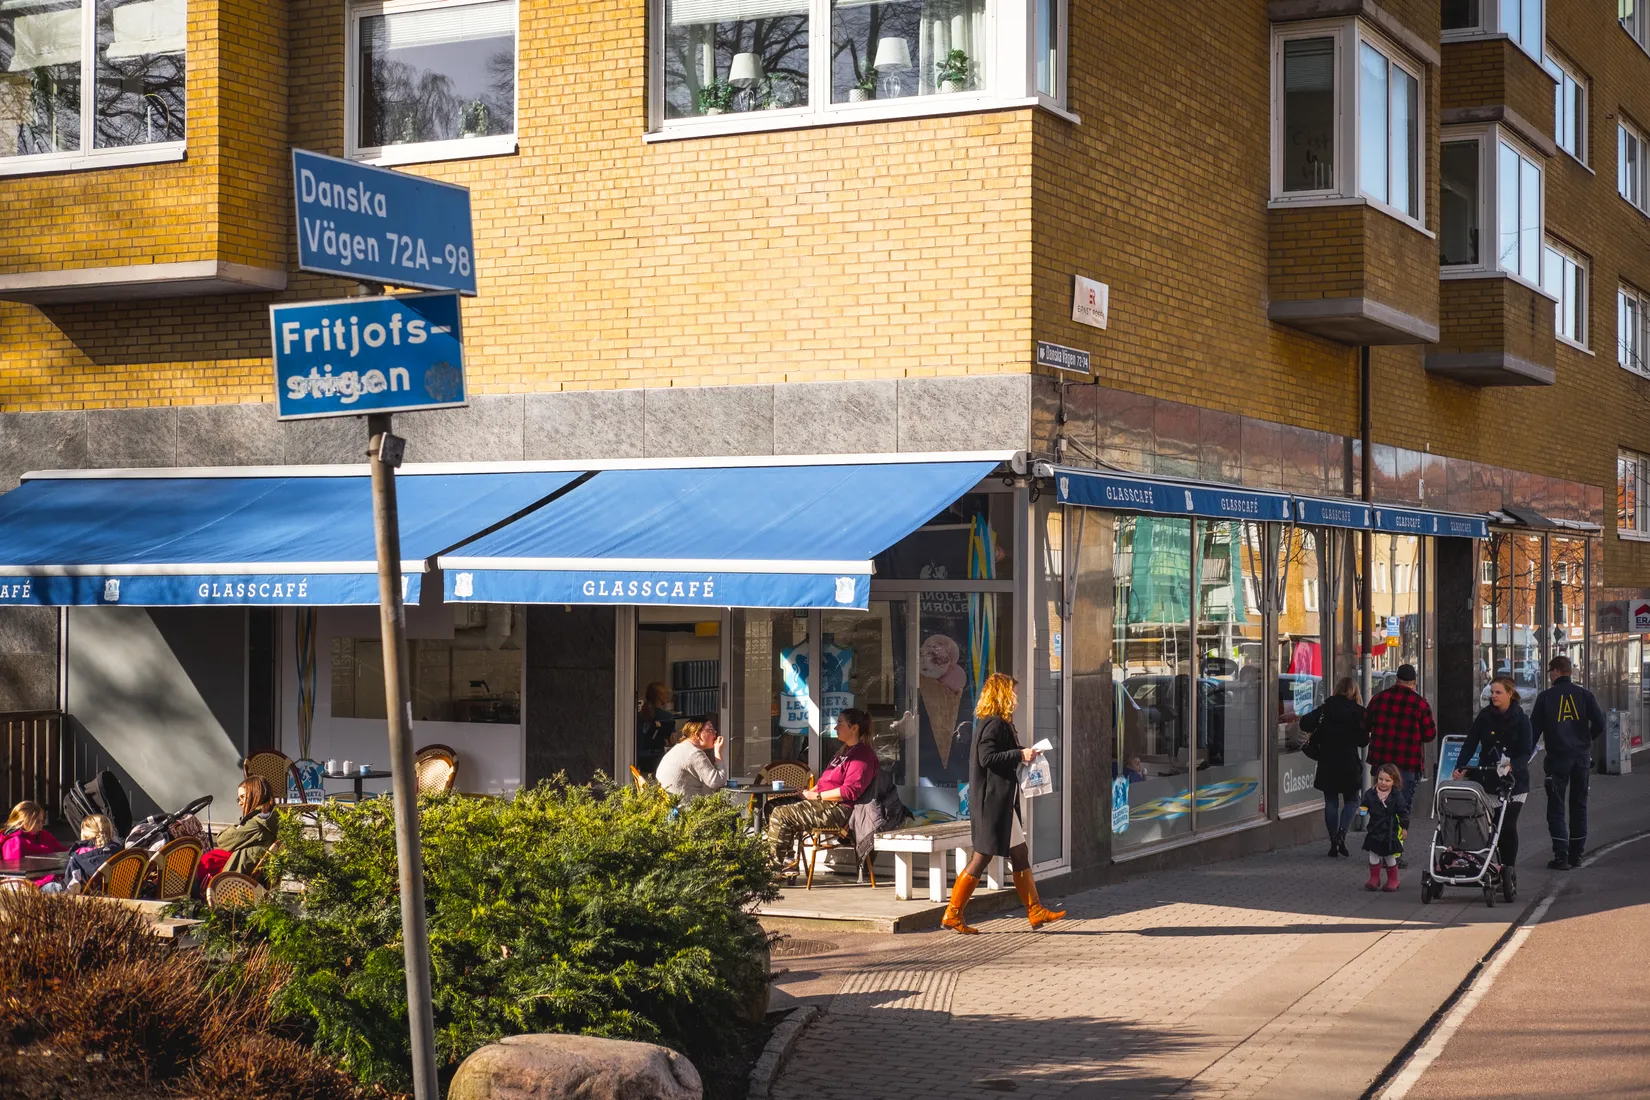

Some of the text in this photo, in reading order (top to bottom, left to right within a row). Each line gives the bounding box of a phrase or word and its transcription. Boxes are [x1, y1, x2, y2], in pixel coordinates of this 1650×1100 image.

[301, 168, 387, 218] Danska
[304, 217, 471, 277] Vägen 72A-98
[282, 313, 452, 358] Fritjofs-
[286, 364, 411, 404] stigen
[1106, 486, 1154, 504] GLASSCAFÉ
[1220, 498, 1259, 513] GLASSCAFÉ
[198, 578, 309, 598] GLASSCAFÉ
[583, 576, 714, 597] GLASSCAFÉ
